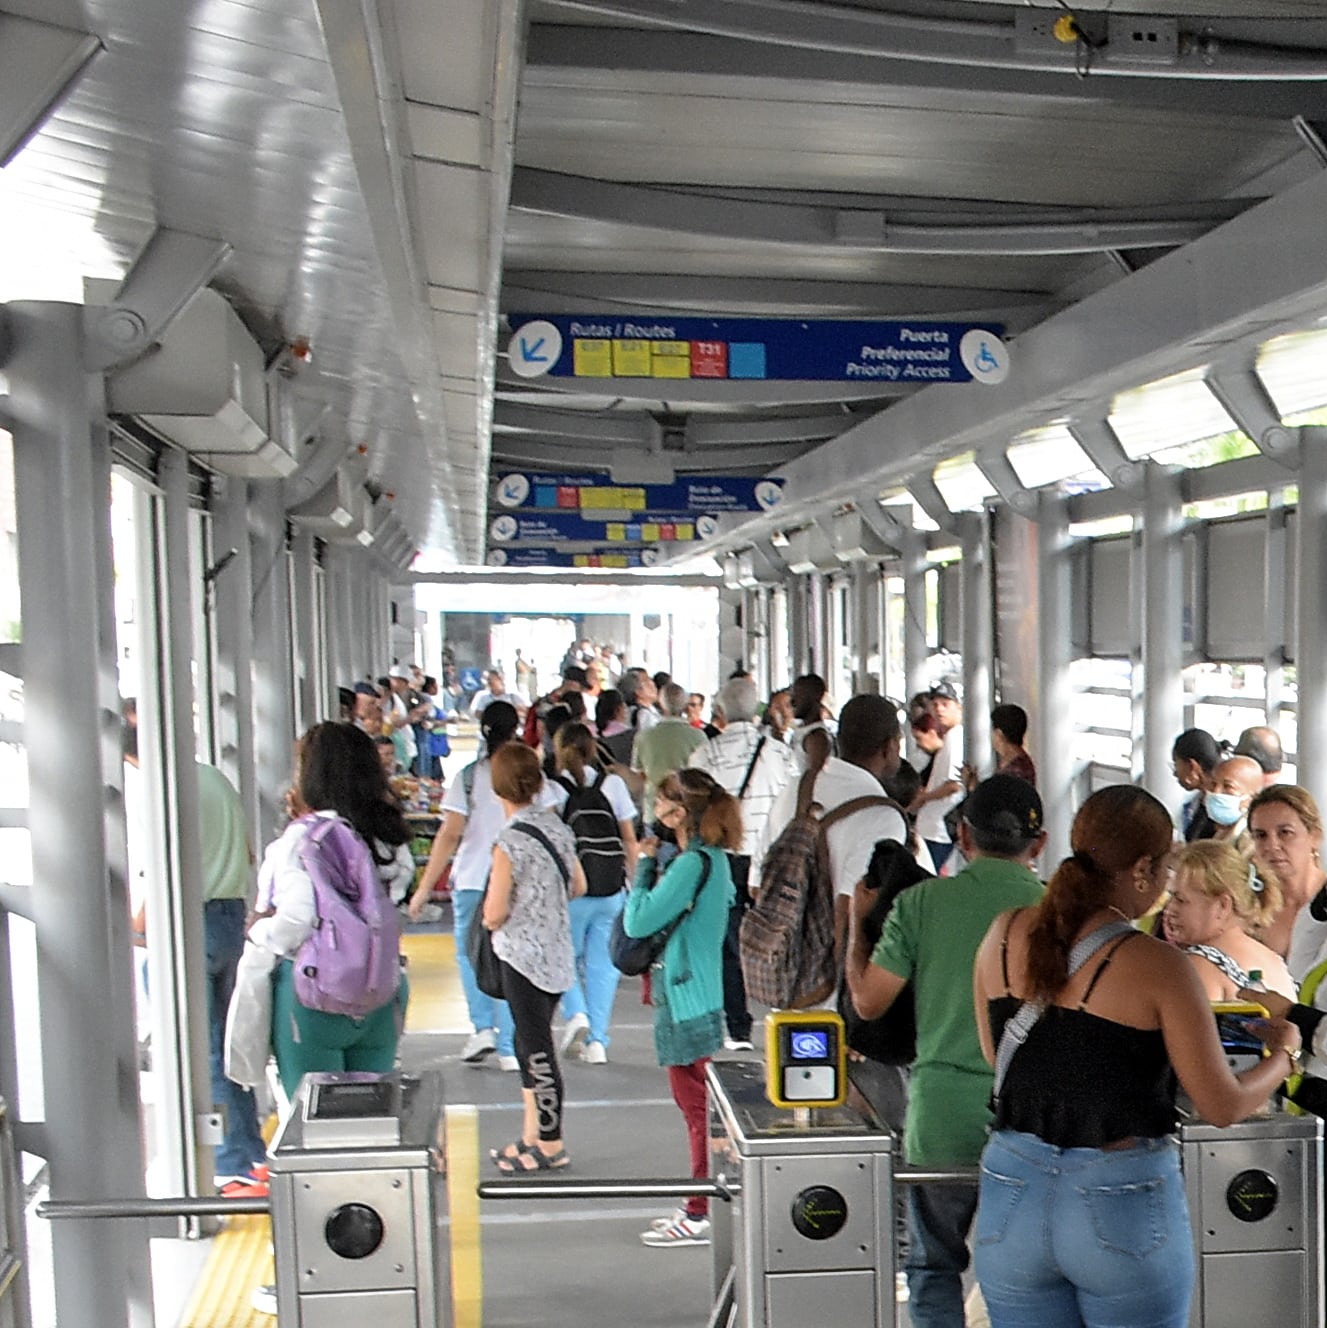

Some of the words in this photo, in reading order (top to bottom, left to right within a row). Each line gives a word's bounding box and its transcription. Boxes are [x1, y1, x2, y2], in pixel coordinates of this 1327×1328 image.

[571, 322, 612, 337] Rutas
[624, 323, 675, 338] Routes
[900, 329, 949, 343] Puerta
[861, 346, 950, 361] Preferencial
[846, 363, 899, 379] Priority
[903, 364, 950, 377] Access
